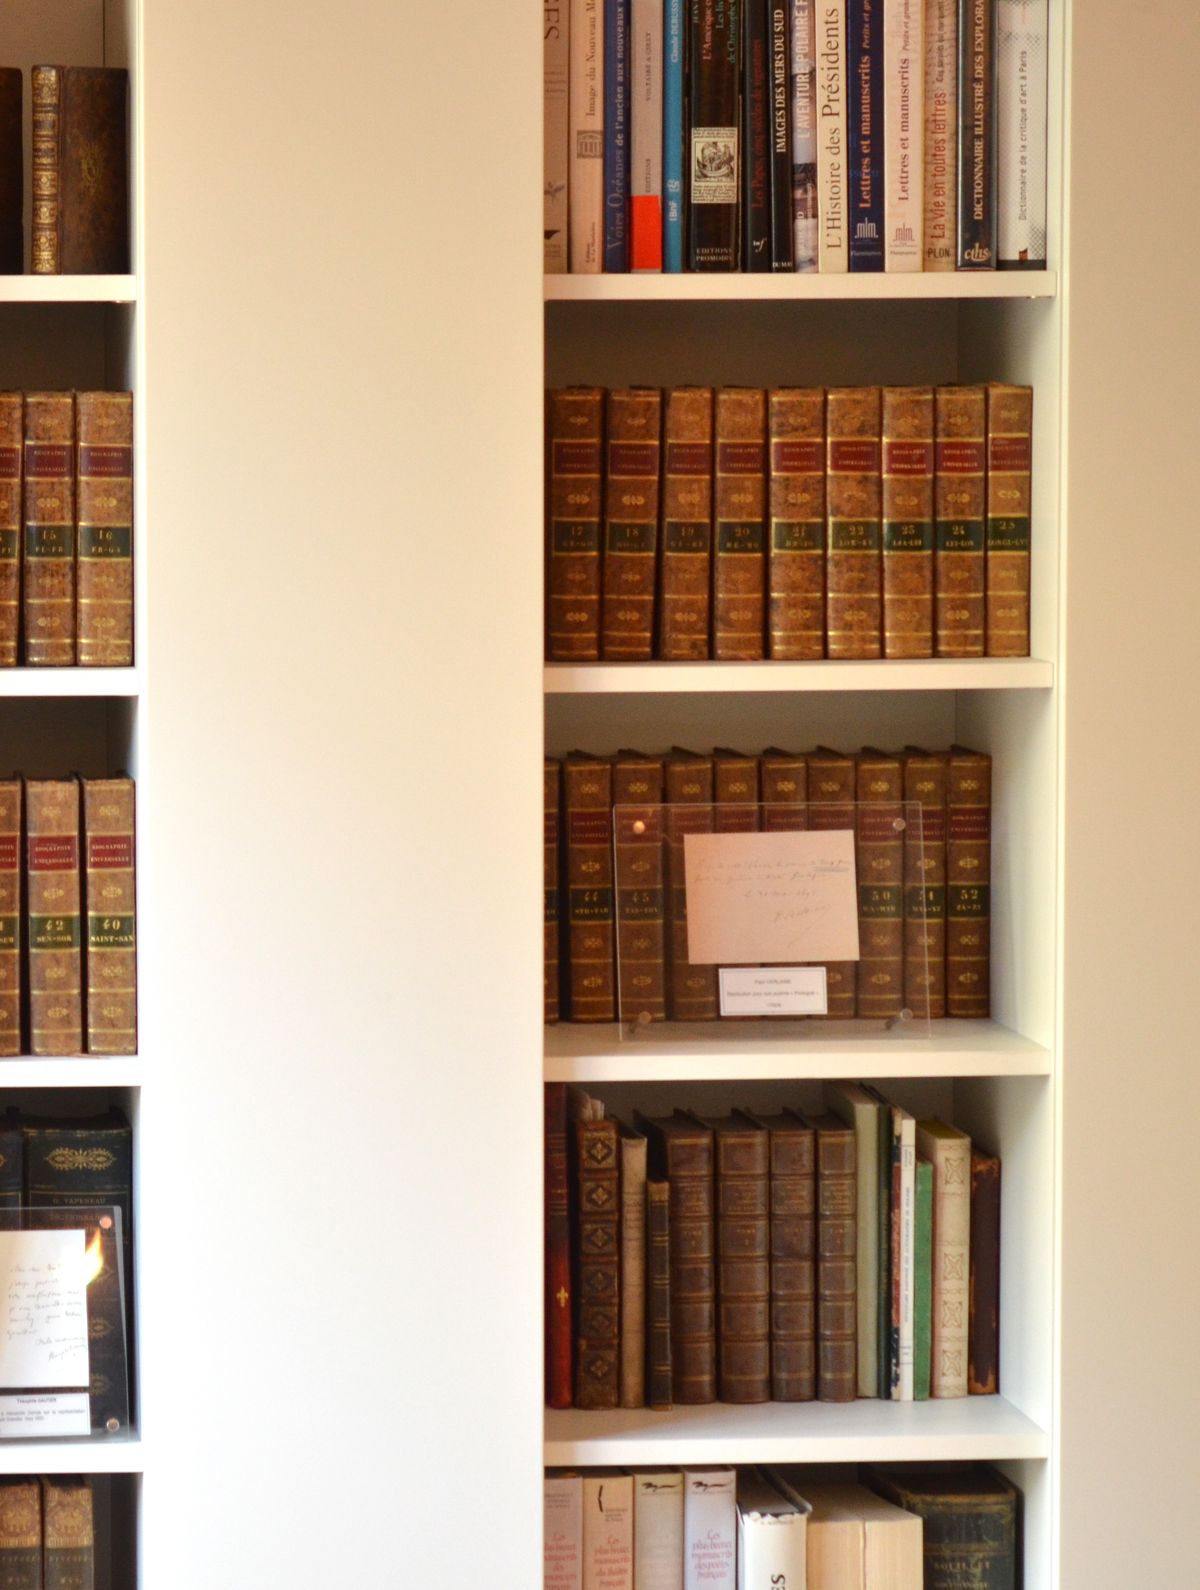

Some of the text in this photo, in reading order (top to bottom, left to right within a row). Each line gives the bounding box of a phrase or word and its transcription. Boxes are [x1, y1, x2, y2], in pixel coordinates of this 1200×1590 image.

[585, 16, 598, 117] Image du Nouveau
[795, 8, 811, 139] L'AVENTURE POLAIRE
[974, 54, 984, 79] DES
[1018, 50, 1027, 73] Paris
[773, 9, 787, 153] IMAGES DES MERS DU SUD
[858, 55, 871, 135] manuscrits
[898, 58, 910, 132] manuscrits
[1018, 84, 1027, 105] d'art
[931, 92, 947, 135] lettres
[972, 81, 984, 135] ILLUSTRÉ
[1018, 107, 1029, 142] critique
[607, 6, 624, 250] Voies Océanes de l'ancien aux nouveaux
[821, 8, 842, 249] L'Histoire des Présidents
[860, 138, 871, 153] et
[899, 136, 909, 149] et
[931, 138, 946, 176] toutes
[1018, 155, 1027, 166] de
[859, 157, 871, 208] Lettres
[898, 153, 909, 201] Lettres
[933, 182, 946, 197] en
[973, 138, 984, 220] DICTIONNAIRE
[1018, 167, 1027, 221] Dictionnaire
[930, 200, 946, 220] vie
[931, 223, 946, 239] La
[927, 247, 951, 259] PLON
[964, 242, 992, 262] cths
[99, 529, 113, 542] 16
